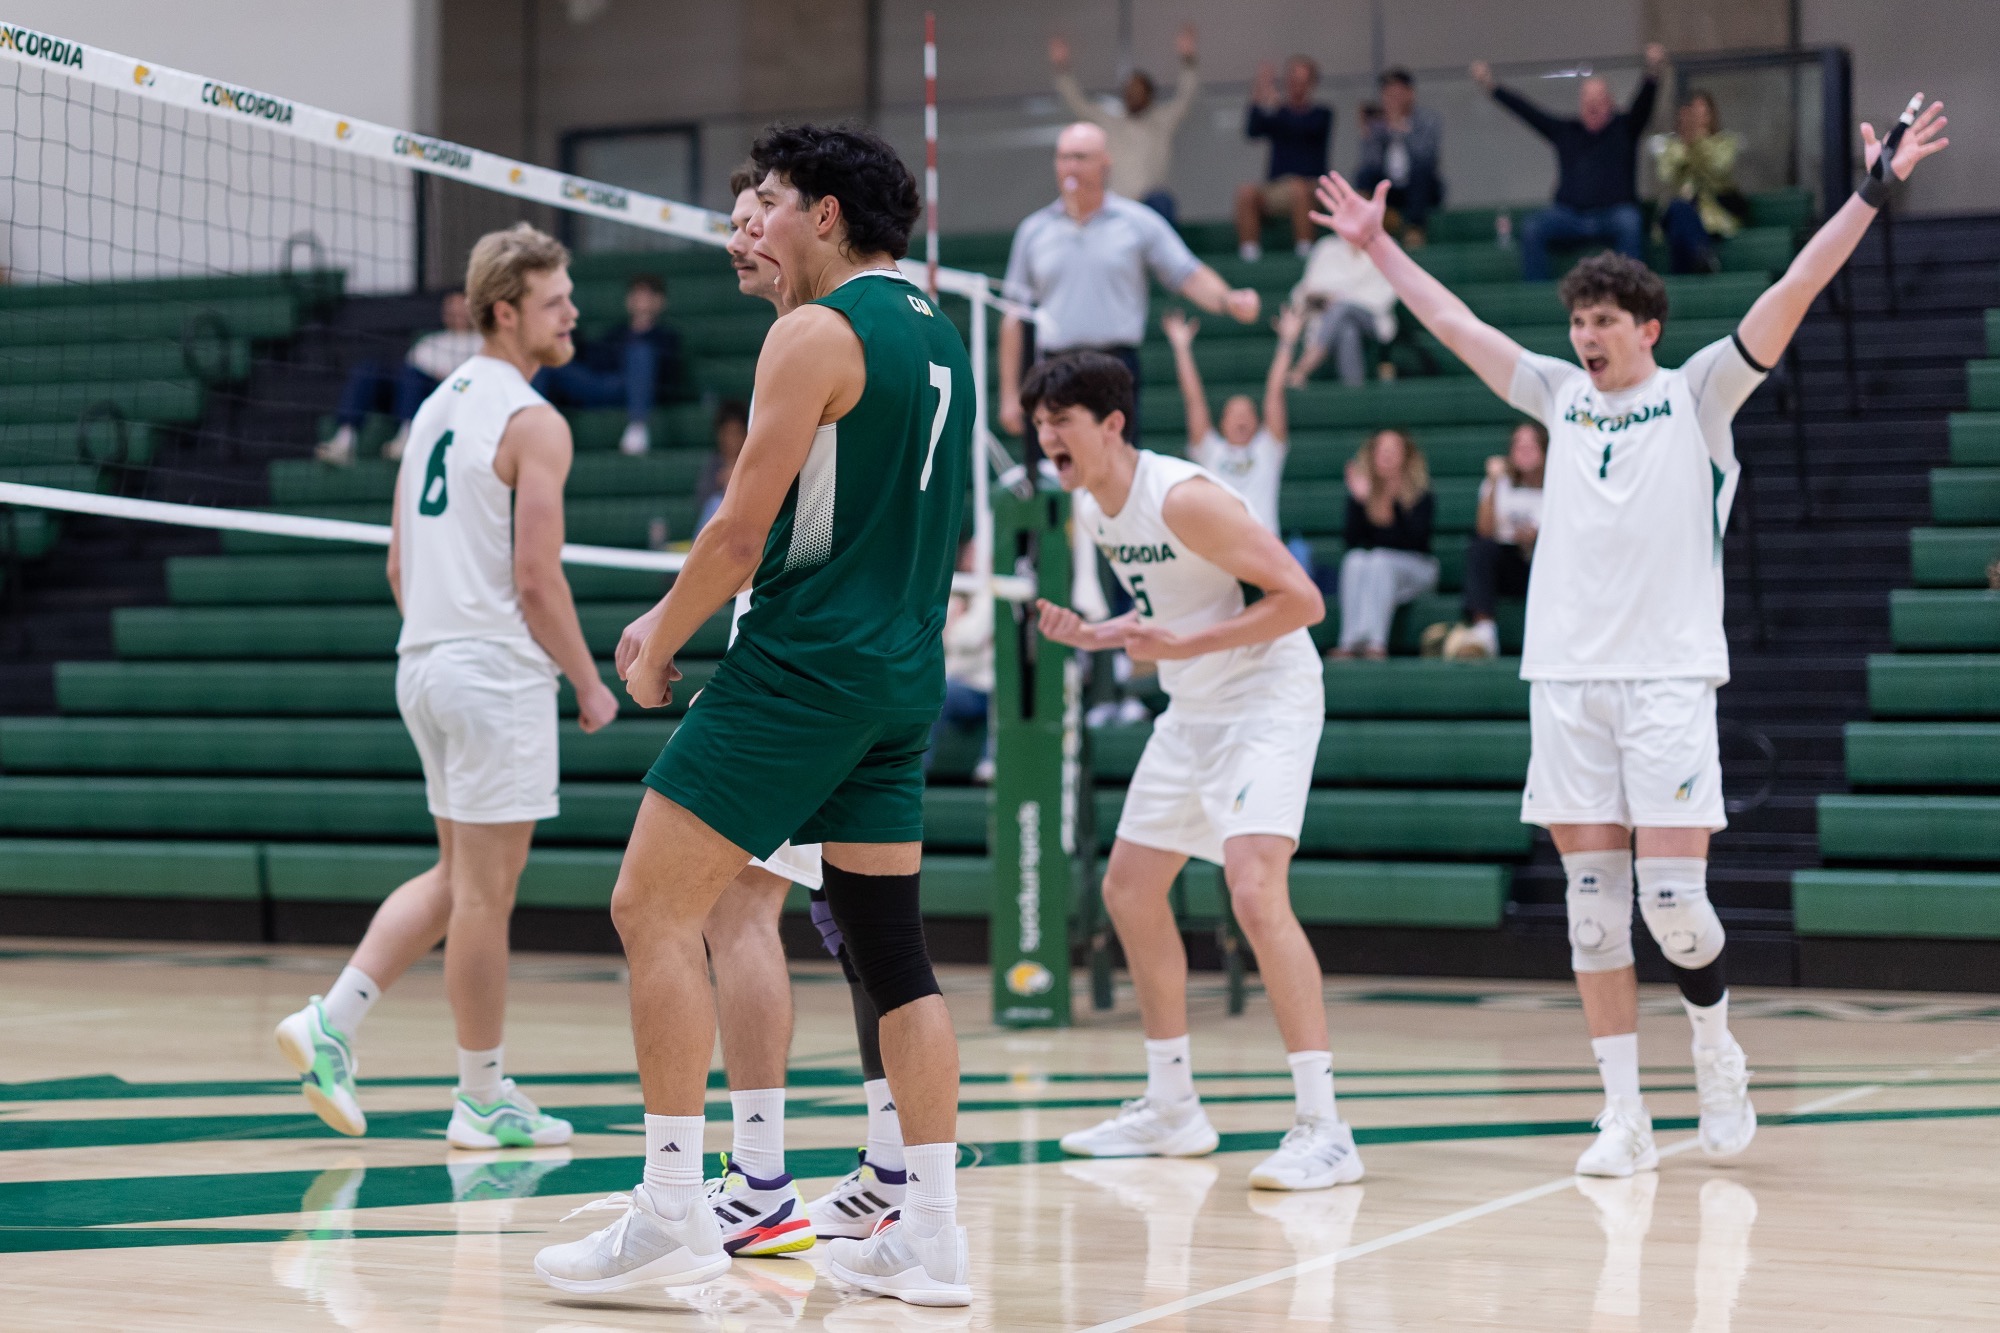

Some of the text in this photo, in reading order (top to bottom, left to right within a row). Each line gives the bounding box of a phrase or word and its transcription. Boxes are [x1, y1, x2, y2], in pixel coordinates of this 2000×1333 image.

[0, 26, 84, 69] NCORDIA
[202, 82, 293, 124] CONCORDIA
[919, 361, 952, 492] 7
[418, 427, 455, 517] 6
[1600, 442, 1613, 479] 1
[1129, 573, 1154, 618] 5
